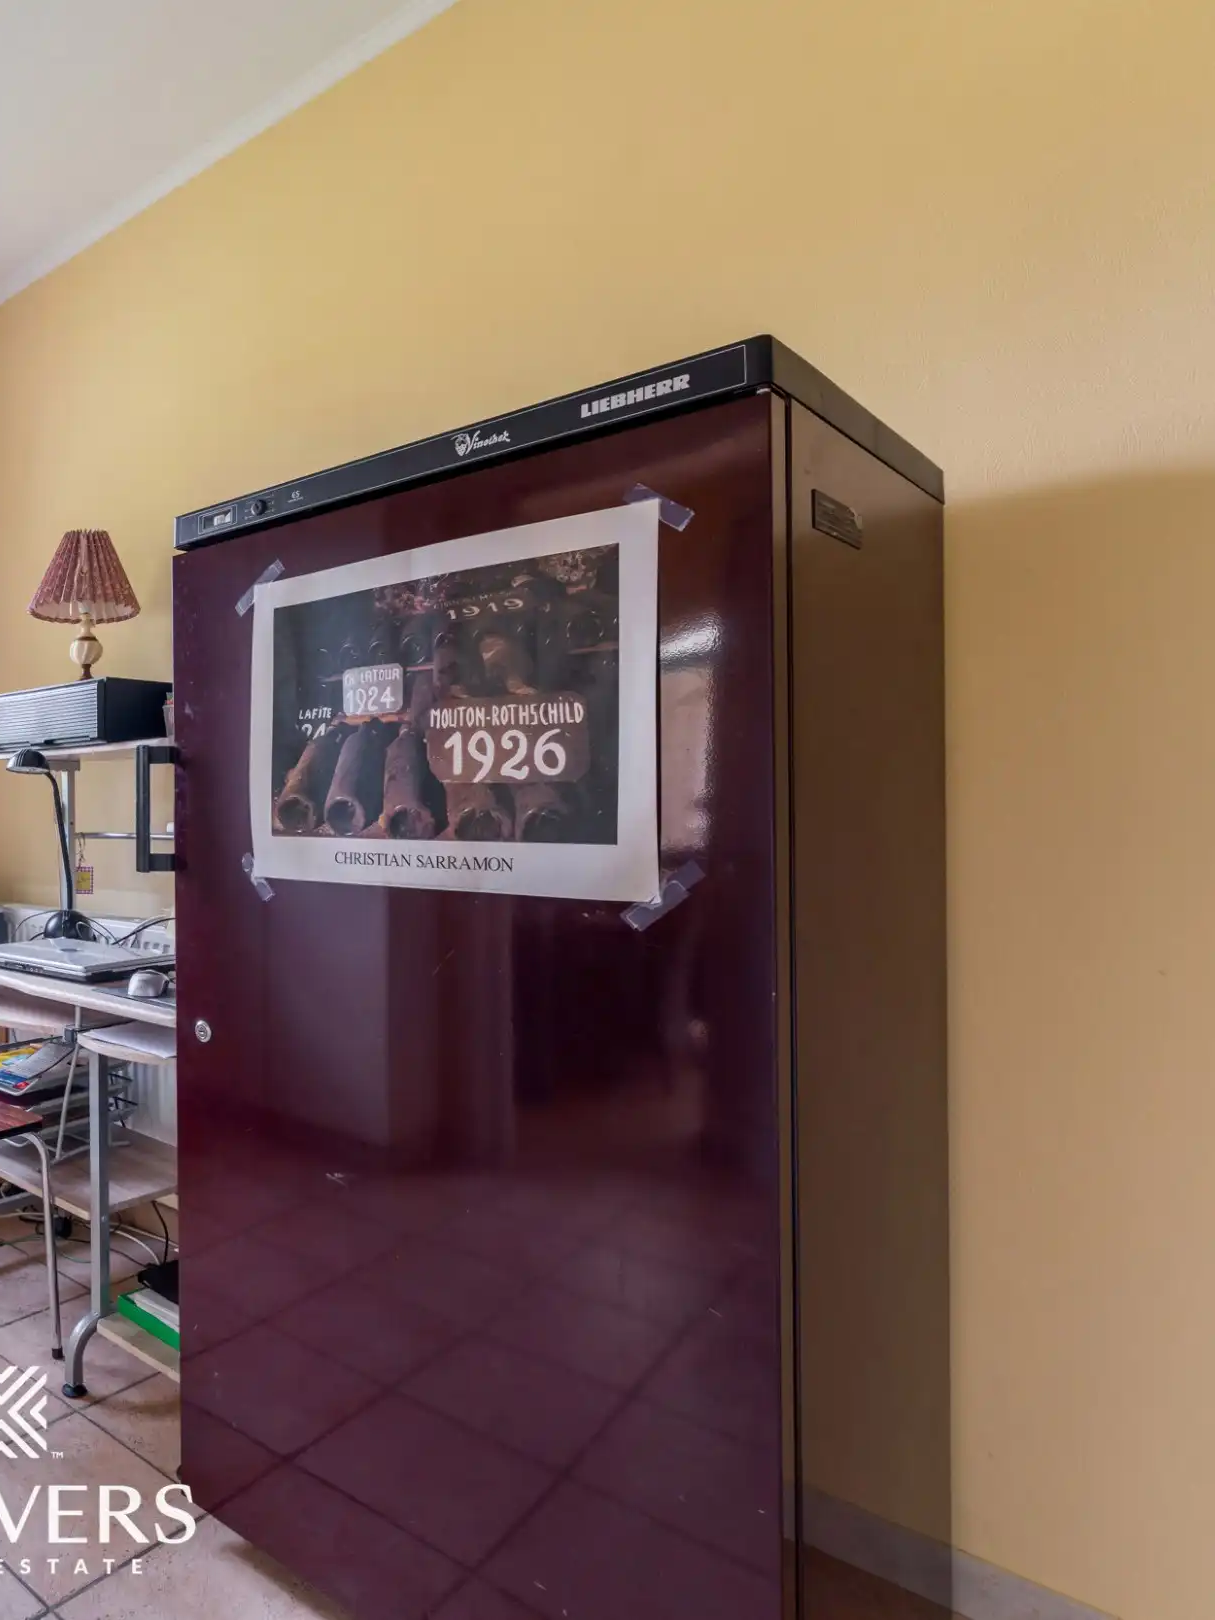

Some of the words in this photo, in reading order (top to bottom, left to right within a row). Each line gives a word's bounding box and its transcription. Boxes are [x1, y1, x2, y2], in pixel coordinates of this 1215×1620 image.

[580, 373, 690, 419] LIEBHERR
[360, 667, 400, 684] LATOUR
[298, 706, 332, 720] LAFITE
[345, 685, 396, 715] 1924
[429, 696, 585, 729] MOUTON-ROTHSCHILD
[443, 728, 567, 784] 1926
[334, 850, 413, 868] CHRISTIAN
[416, 854, 514, 873] SARRAMON
